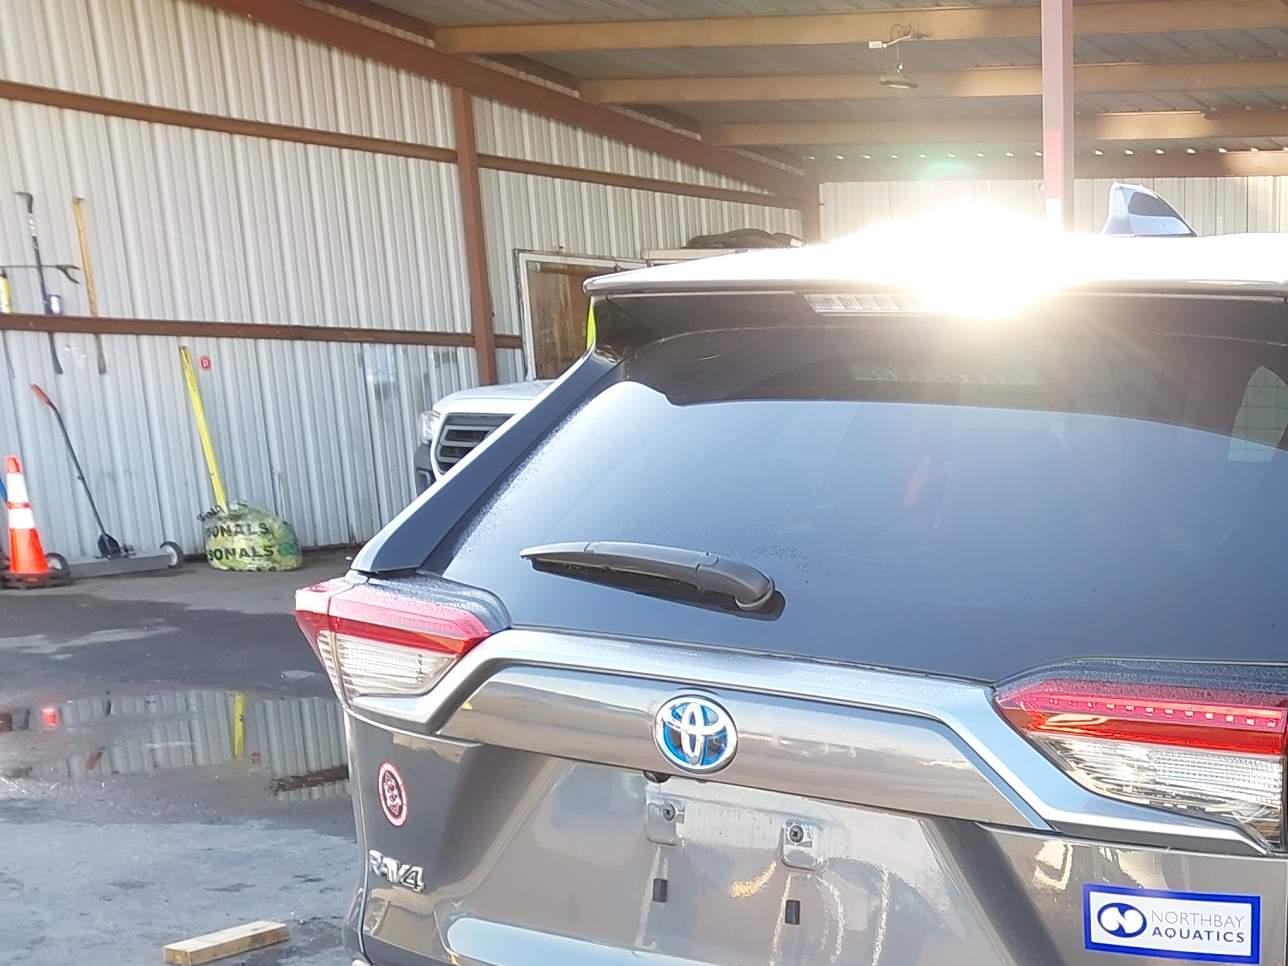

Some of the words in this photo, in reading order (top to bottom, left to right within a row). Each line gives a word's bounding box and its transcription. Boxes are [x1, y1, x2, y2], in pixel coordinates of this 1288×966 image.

[369, 849, 426, 893] RAV4
[1151, 909, 1245, 928] NORTHBAY
[1152, 926, 1245, 943] AQUATICS
